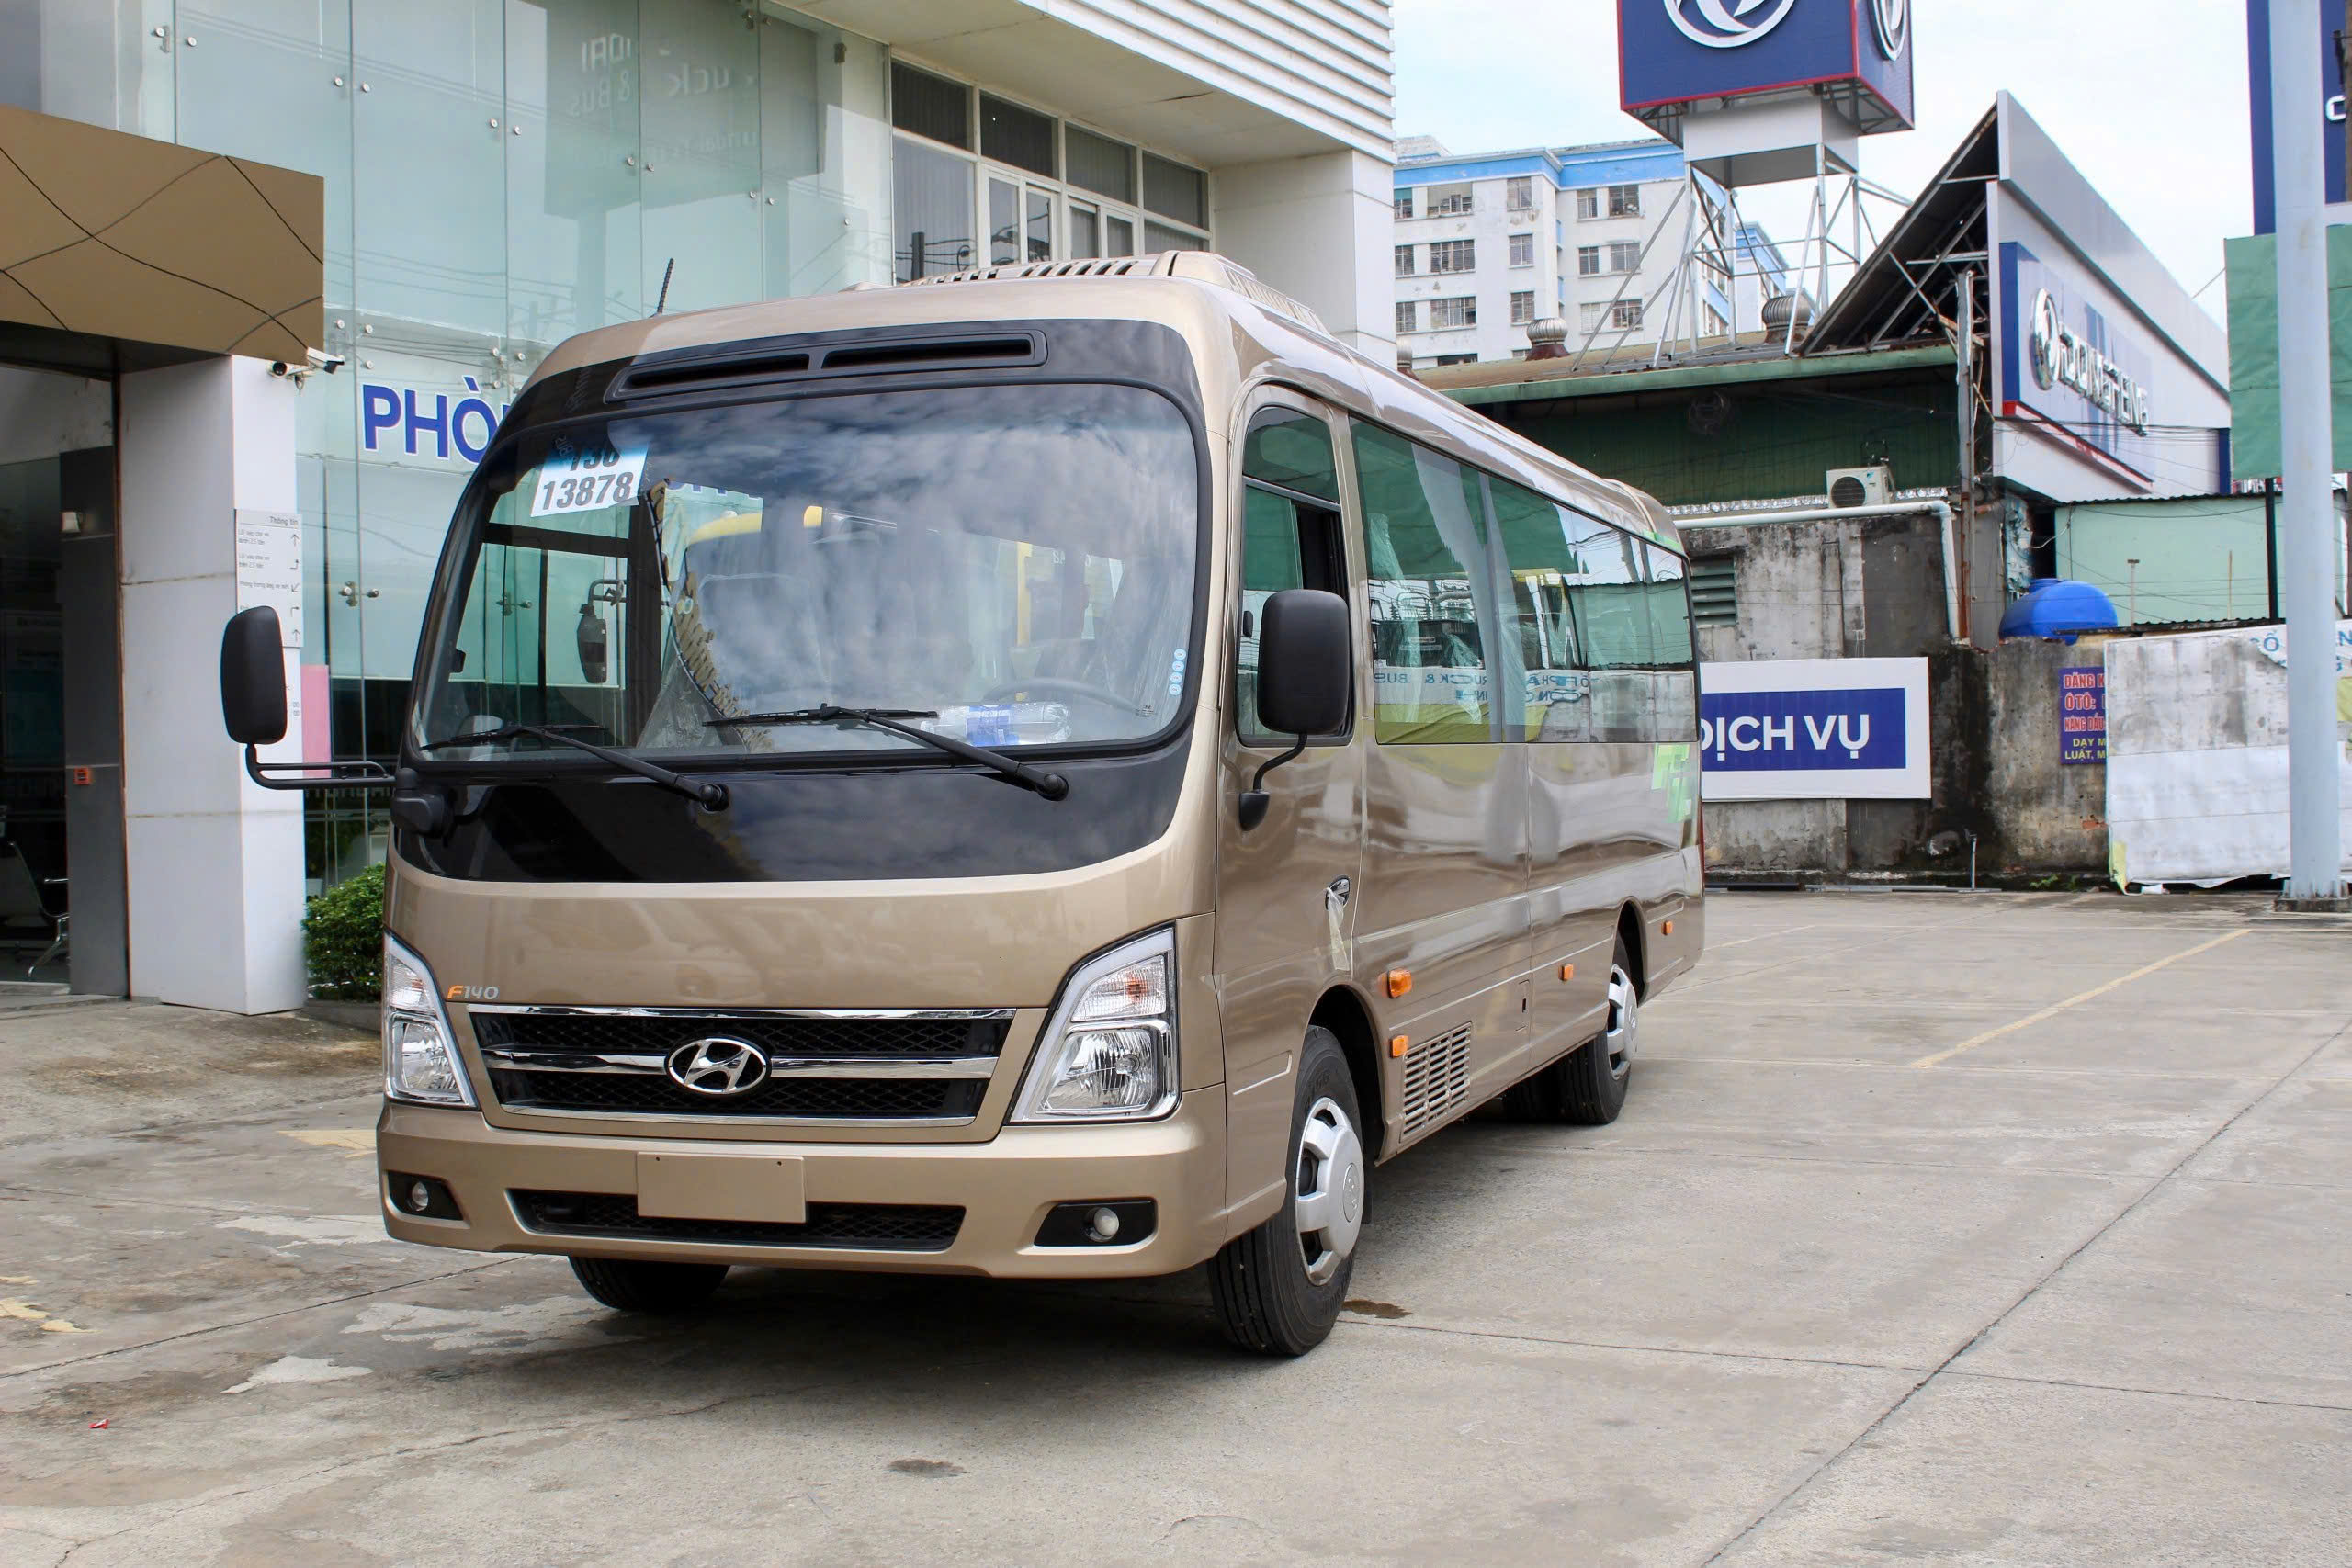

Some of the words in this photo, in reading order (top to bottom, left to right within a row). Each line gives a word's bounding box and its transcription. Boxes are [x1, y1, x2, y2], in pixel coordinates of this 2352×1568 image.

[362, 376, 511, 465] PHÒ
[542, 471, 634, 510] 13878
[2097, 673, 2106, 688] K
[1803, 714, 1870, 759] VỤ
[447, 985, 499, 999] F140
